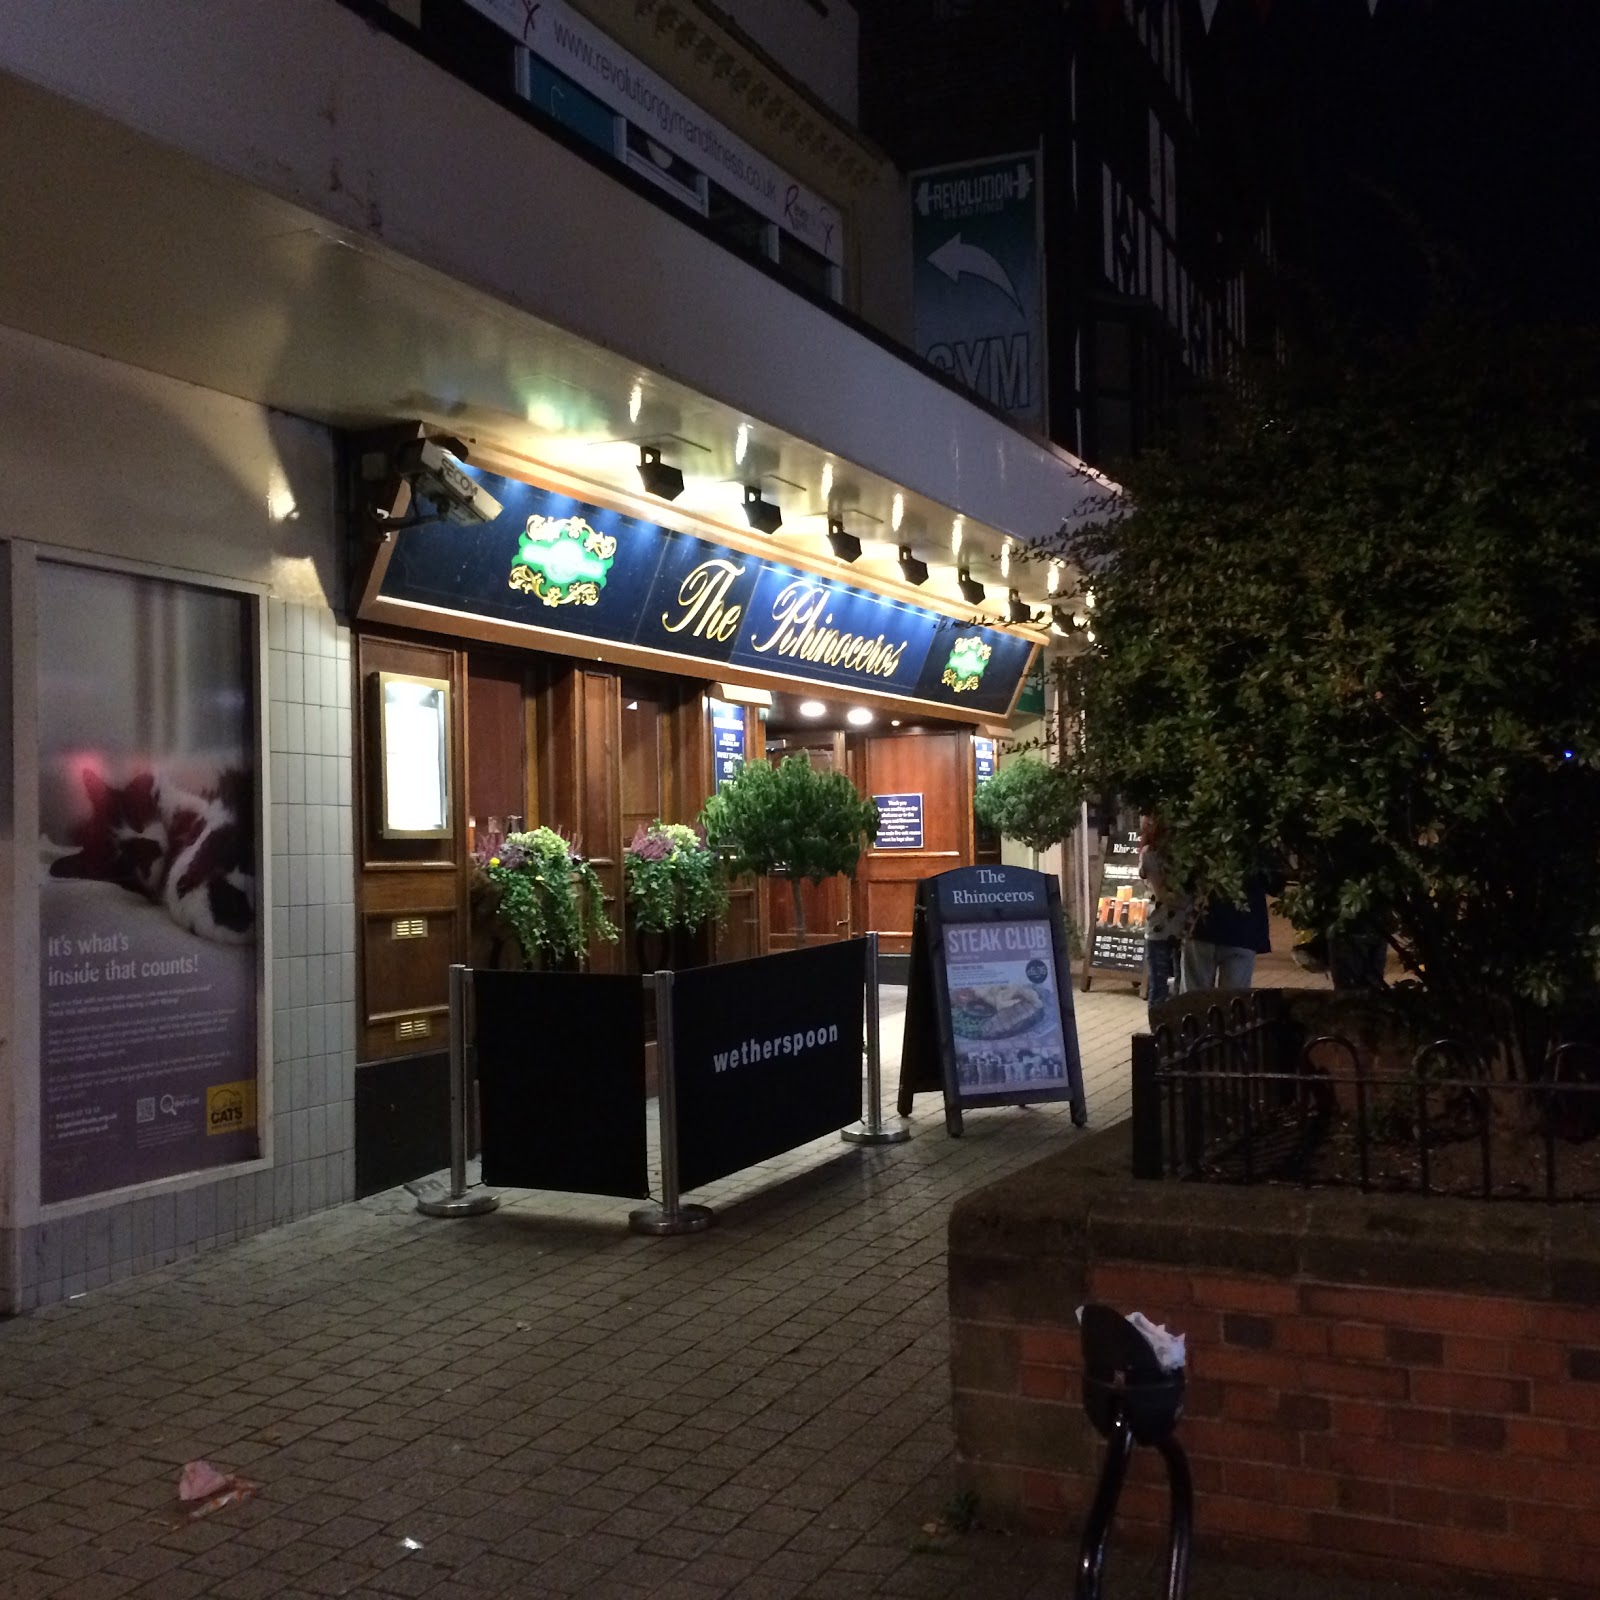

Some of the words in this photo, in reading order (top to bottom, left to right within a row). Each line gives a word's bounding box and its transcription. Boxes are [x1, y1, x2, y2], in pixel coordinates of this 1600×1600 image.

[933, 170, 1014, 211] REVOLUTION
[661, 559, 746, 643] The
[750, 579, 908, 679] Rhinoceros
[976, 869, 1006, 884] The
[952, 888, 1035, 905] Rhinoceros
[48, 935, 73, 958] It's
[78, 931, 130, 956] what's
[947, 927, 1003, 953] STEAK
[1004, 925, 1047, 950] CLUB
[48, 962, 100, 987] inside
[105, 959, 137, 982] that
[141, 954, 200, 978] counts!
[713, 1023, 839, 1074] wetherspoon
[211, 1107, 243, 1125] CATS
